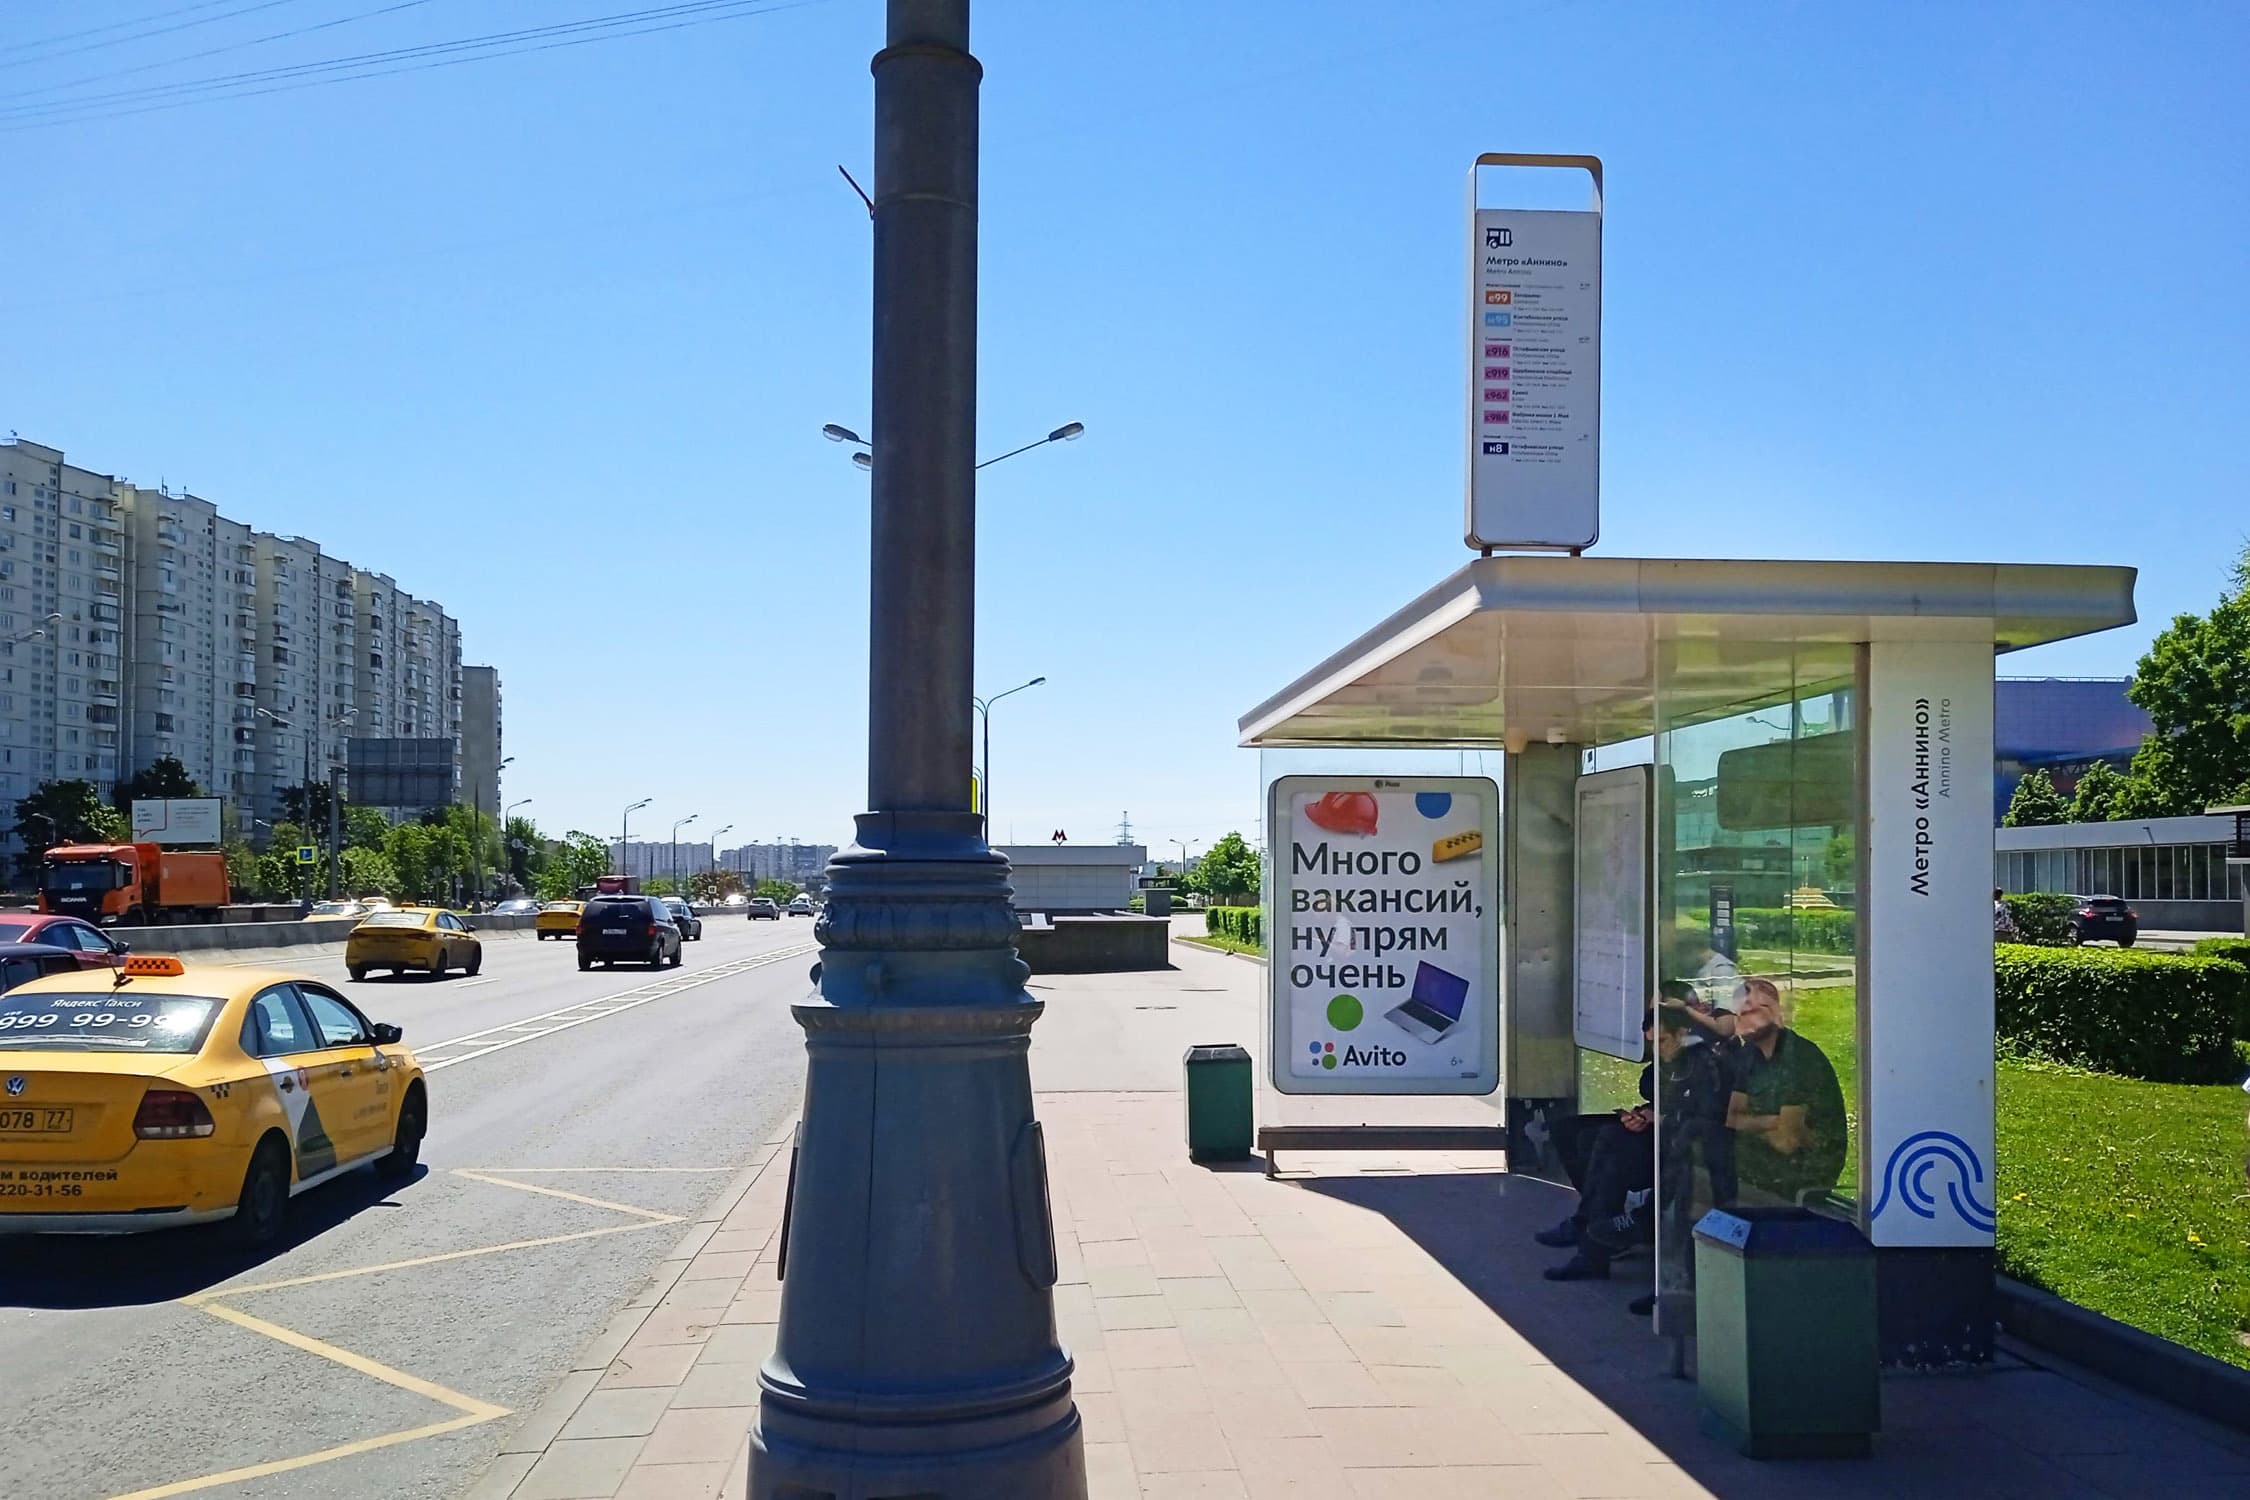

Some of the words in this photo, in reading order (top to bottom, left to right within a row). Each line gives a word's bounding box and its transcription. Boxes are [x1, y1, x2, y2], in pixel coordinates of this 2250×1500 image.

[1486, 256, 1519, 267] Метро
[1521, 257, 1568, 267] «Аннино»
[1938, 698, 1951, 743] Metro
[1910, 698, 1930, 810] «Аннино»
[1938, 746, 1951, 798] Annino
[1291, 842, 1421, 876] Много
[1910, 816, 1933, 896] Метро
[1291, 880, 1483, 918] вакансий,
[1291, 926, 1336, 957] ну
[1350, 926, 1447, 957] прям
[1290, 963, 1407, 989] очень
[50, 999, 101, 1008] Яндекс
[104, 998, 142, 1008] Такси
[0, 1014, 59, 1030] 999
[1342, 1045, 1407, 1067] Avito
[0, 1112, 34, 1129] 078
[47, 1110, 66, 1124] 77
[20, 1169, 118, 1182] водителей
